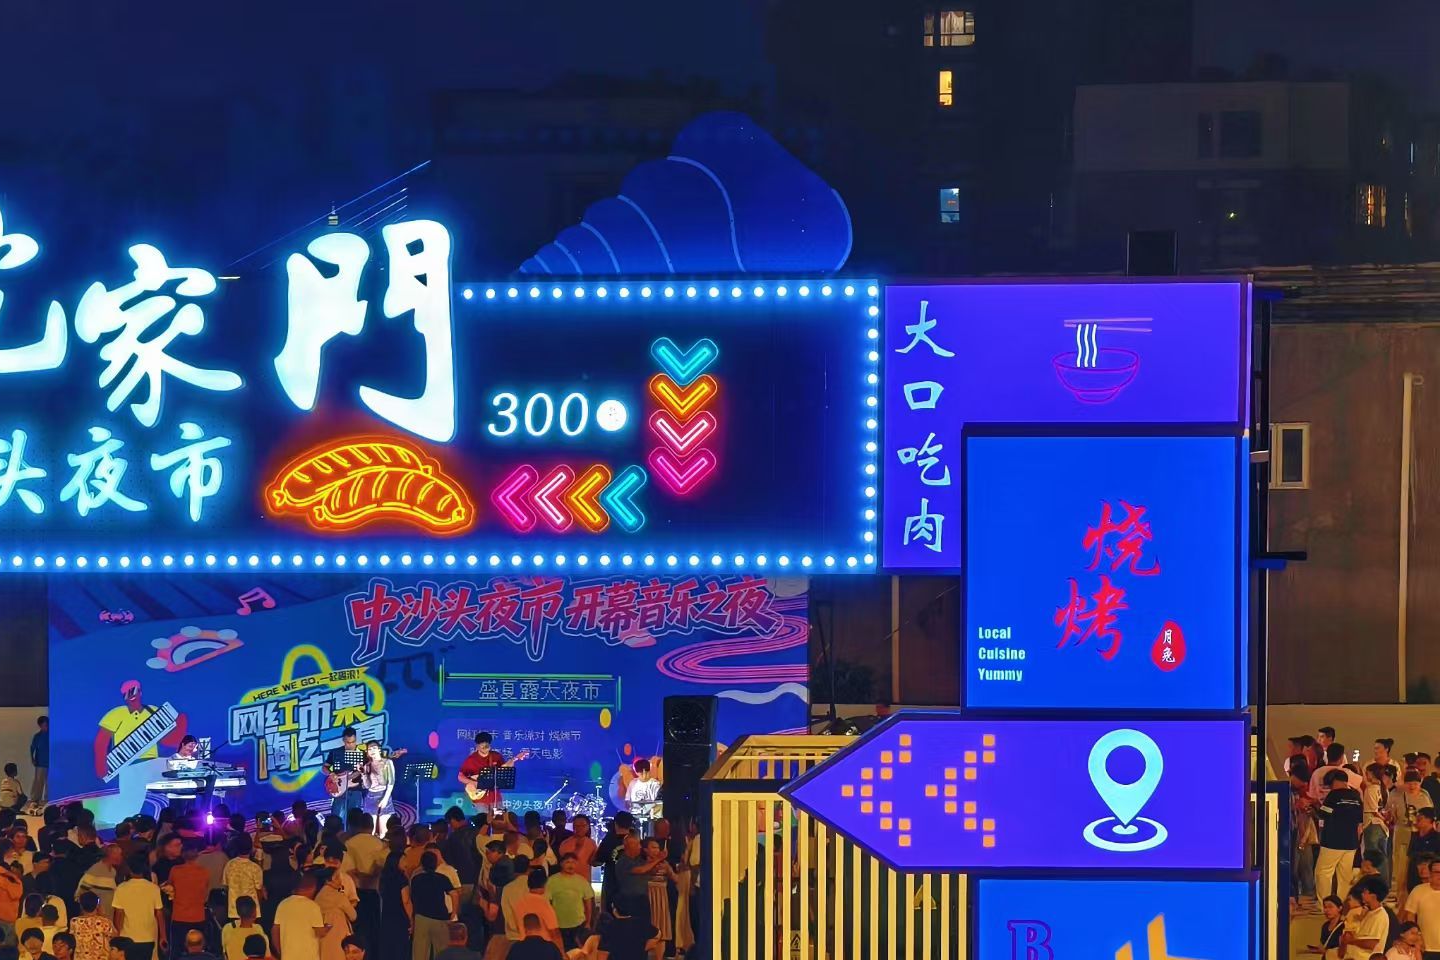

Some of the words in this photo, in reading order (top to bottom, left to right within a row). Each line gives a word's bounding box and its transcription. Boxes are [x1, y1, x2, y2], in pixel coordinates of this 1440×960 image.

[894, 299, 956, 554] 大口吃肉
[1054, 499, 1162, 662] 烧烤
[348, 575, 564, 658] 中沙头夜市
[565, 576, 781, 642] 开幕音乐之夜
[978, 626, 1012, 641] Local
[978, 646, 1026, 661] Cuisine
[978, 667, 1023, 682] Yummy
[253, 688, 279, 702] HERE
[282, 681, 298, 692] WE
[478, 679, 603, 701] 盛夏露天夜市
[232, 684, 369, 741] 网红市集
